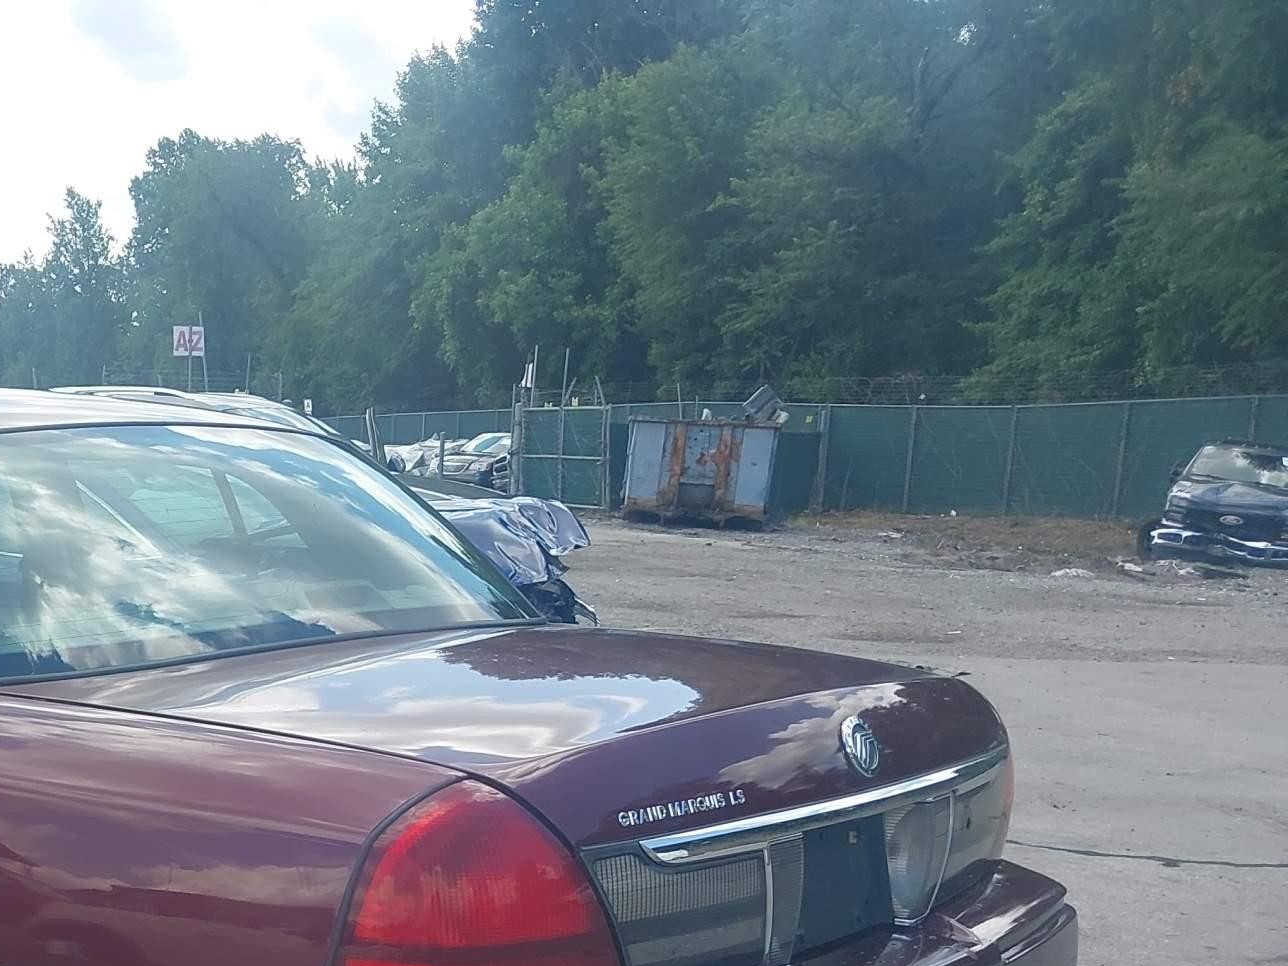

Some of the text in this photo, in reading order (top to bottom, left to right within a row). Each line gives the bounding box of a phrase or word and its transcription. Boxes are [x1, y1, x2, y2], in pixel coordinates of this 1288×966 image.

[175, 330, 189, 352] A
[618, 789, 746, 827] GRAND MARQUIS LS
